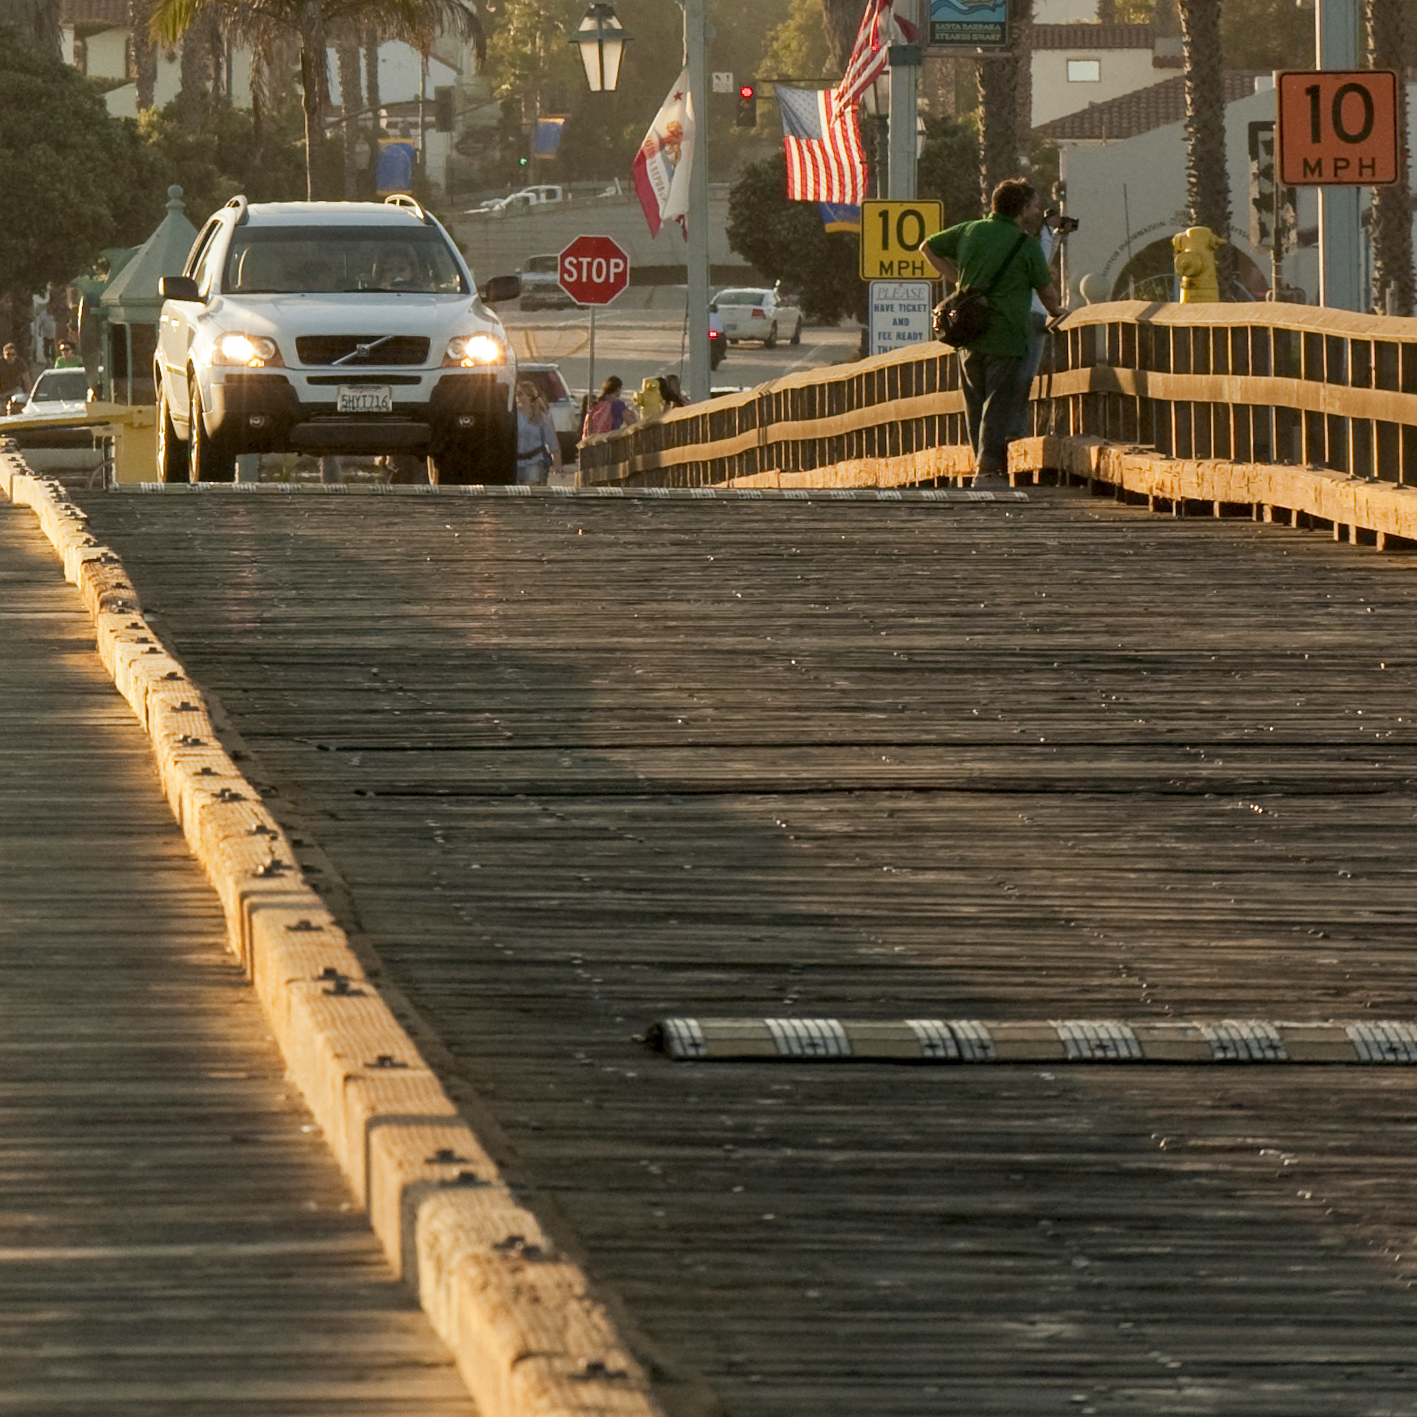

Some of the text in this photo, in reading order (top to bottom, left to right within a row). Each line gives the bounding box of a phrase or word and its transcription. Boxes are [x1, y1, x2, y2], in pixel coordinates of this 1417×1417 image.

[1305, 83, 1374, 144] 10
[1303, 157, 1376, 178] MPH
[878, 209, 925, 252] 10
[564, 256, 624, 283] STOP
[879, 260, 925, 276] MPH
[877, 287, 925, 298] PLEASE
[874, 304, 928, 313] HAVE TICKET
[892, 317, 910, 326] AND
[878, 332, 924, 340] FEE READY
